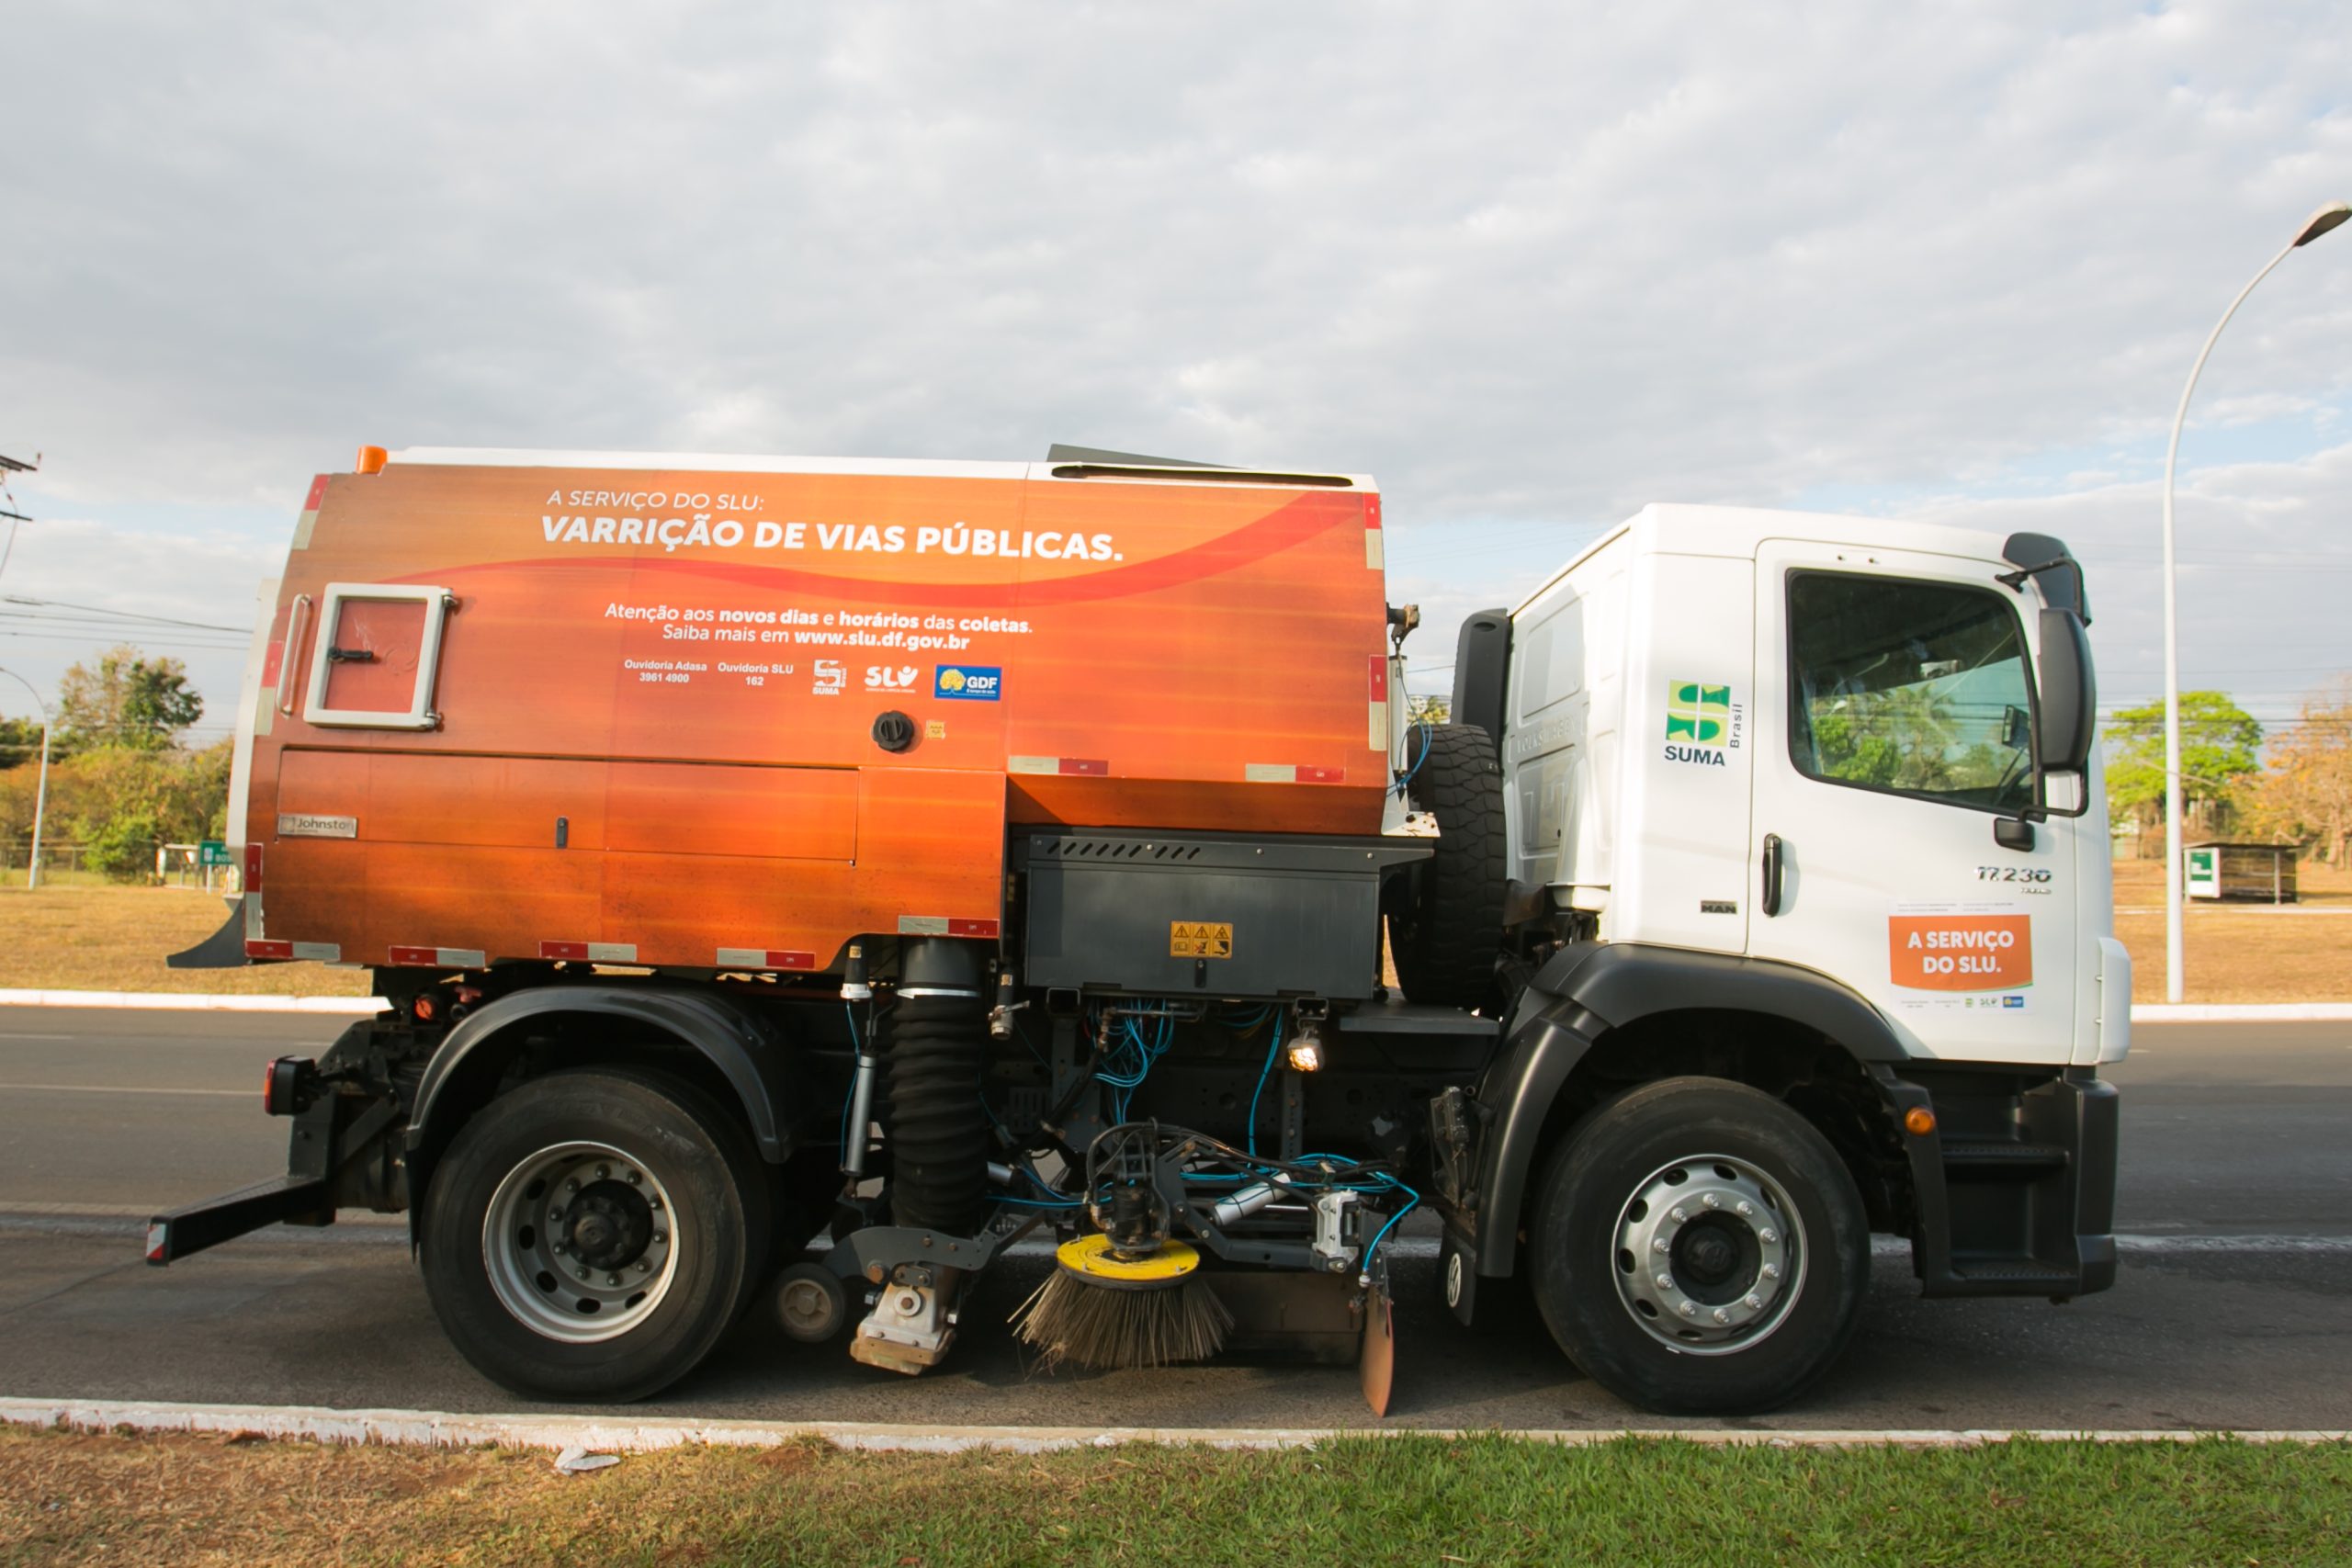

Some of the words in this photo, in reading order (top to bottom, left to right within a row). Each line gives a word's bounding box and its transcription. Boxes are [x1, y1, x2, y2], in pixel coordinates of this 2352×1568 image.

[547, 490, 562, 505] A
[568, 490, 668, 512] SERVIÇO
[673, 492, 710, 510] DO
[716, 493, 764, 512] SLU:
[542, 513, 744, 552] VARRIÇÃO
[753, 521, 807, 549] DE
[816, 523, 906, 553] VIAS
[916, 522, 1124, 561] PÚBLICAS.
[605, 602, 680, 623] Atenção
[683, 609, 715, 622] aos
[718, 610, 776, 624] novos
[779, 608, 819, 626] dias
[822, 614, 835, 626] e
[839, 610, 920, 629] horários
[923, 614, 956, 630] das
[958, 616, 1033, 633] coletas.
[662, 623, 710, 640] Saiba
[714, 626, 756, 642] mais
[760, 630, 789, 643] em
[794, 628, 971, 652] www.slu.df.gov.br
[624, 659, 674, 671] Ouvidoria
[674, 660, 707, 672] Adasa
[717, 661, 769, 673] Ouvidoria
[771, 663, 794, 674] SLU
[639, 671, 662, 682] 3961
[664, 672, 690, 683] 4900
[745, 675, 764, 686] 162
[967, 676, 998, 689] GDF
[812, 686, 840, 696] SUMA
[1730, 704, 1743, 748] Brasil
[1664, 745, 1725, 766] SUMA
[1907, 931, 1923, 949] A
[1926, 930, 2015, 953] SERVIÇO
[1923, 955, 1955, 974] DO
[1958, 955, 2001, 974] SLU.
